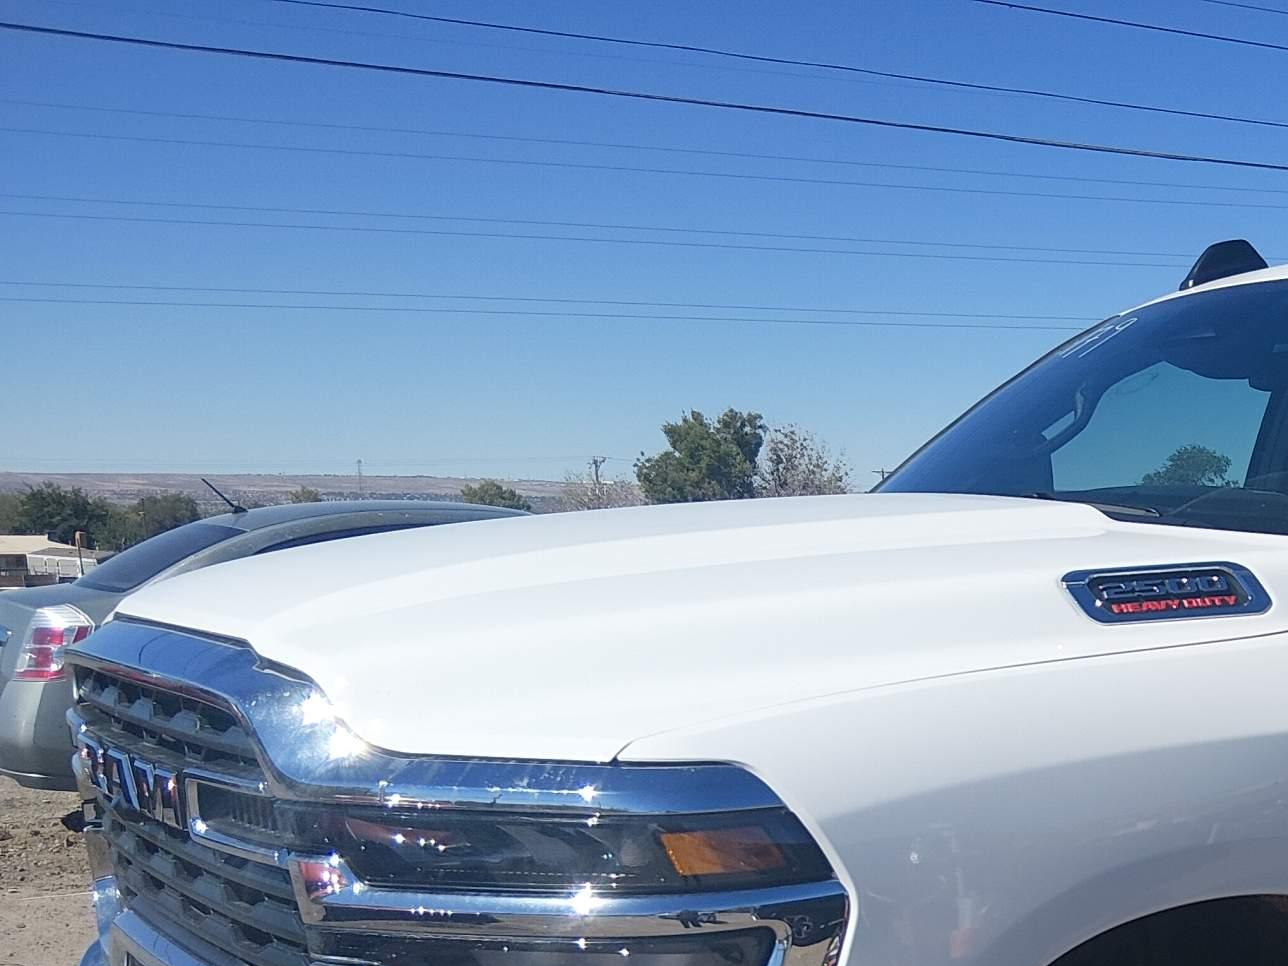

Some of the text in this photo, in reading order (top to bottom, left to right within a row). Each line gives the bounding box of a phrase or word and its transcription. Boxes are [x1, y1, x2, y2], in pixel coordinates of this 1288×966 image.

[1098, 575, 1228, 599] 2500
[1111, 595, 1237, 614] HEAVY DUTY
